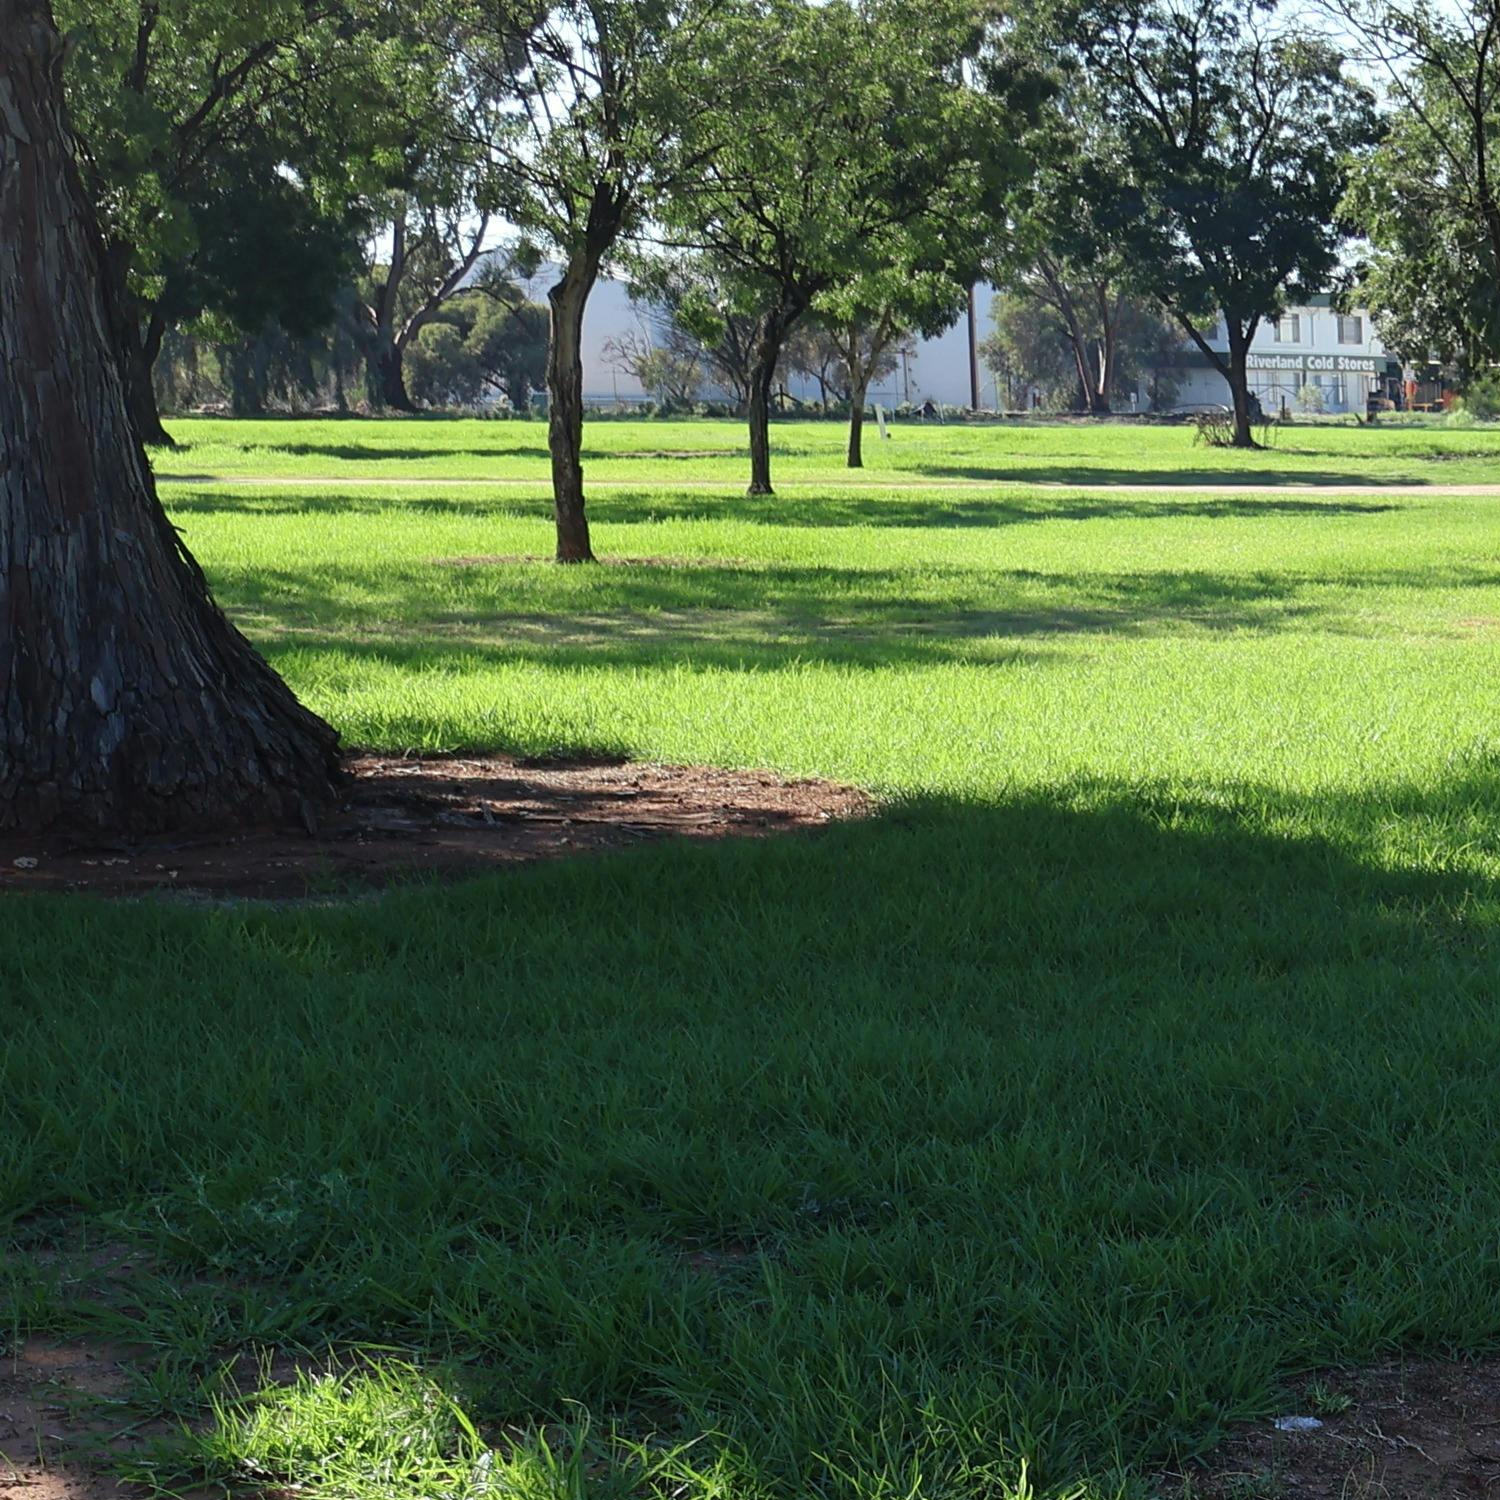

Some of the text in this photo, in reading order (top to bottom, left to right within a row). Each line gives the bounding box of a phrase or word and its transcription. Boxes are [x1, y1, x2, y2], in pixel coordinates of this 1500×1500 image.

[1246, 354, 1375, 371] Riverland Cold Stores
